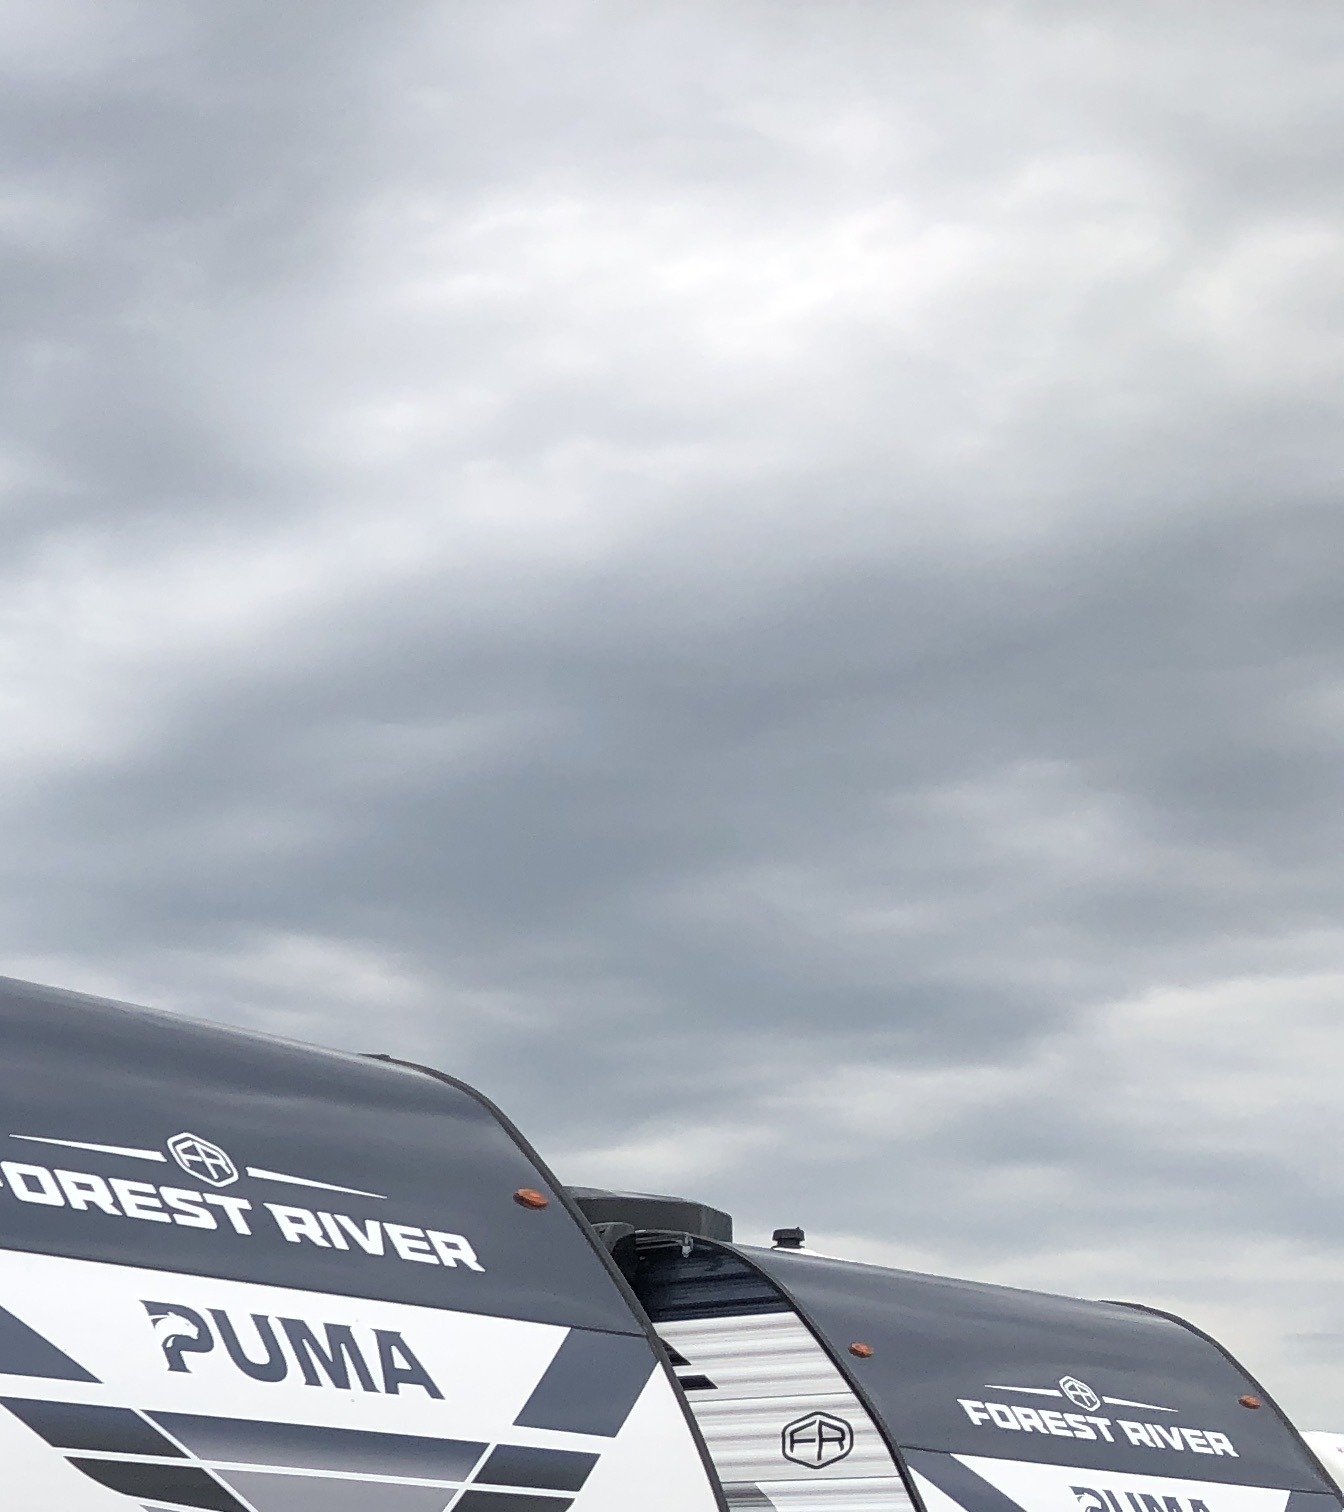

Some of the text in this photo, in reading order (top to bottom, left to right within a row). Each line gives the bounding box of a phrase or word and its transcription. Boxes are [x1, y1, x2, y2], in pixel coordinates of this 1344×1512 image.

[263, 1202, 486, 1273] RIVER
[140, 1299, 446, 1400] PUMA
[957, 1399, 1239, 1457] FOREST RIVER
